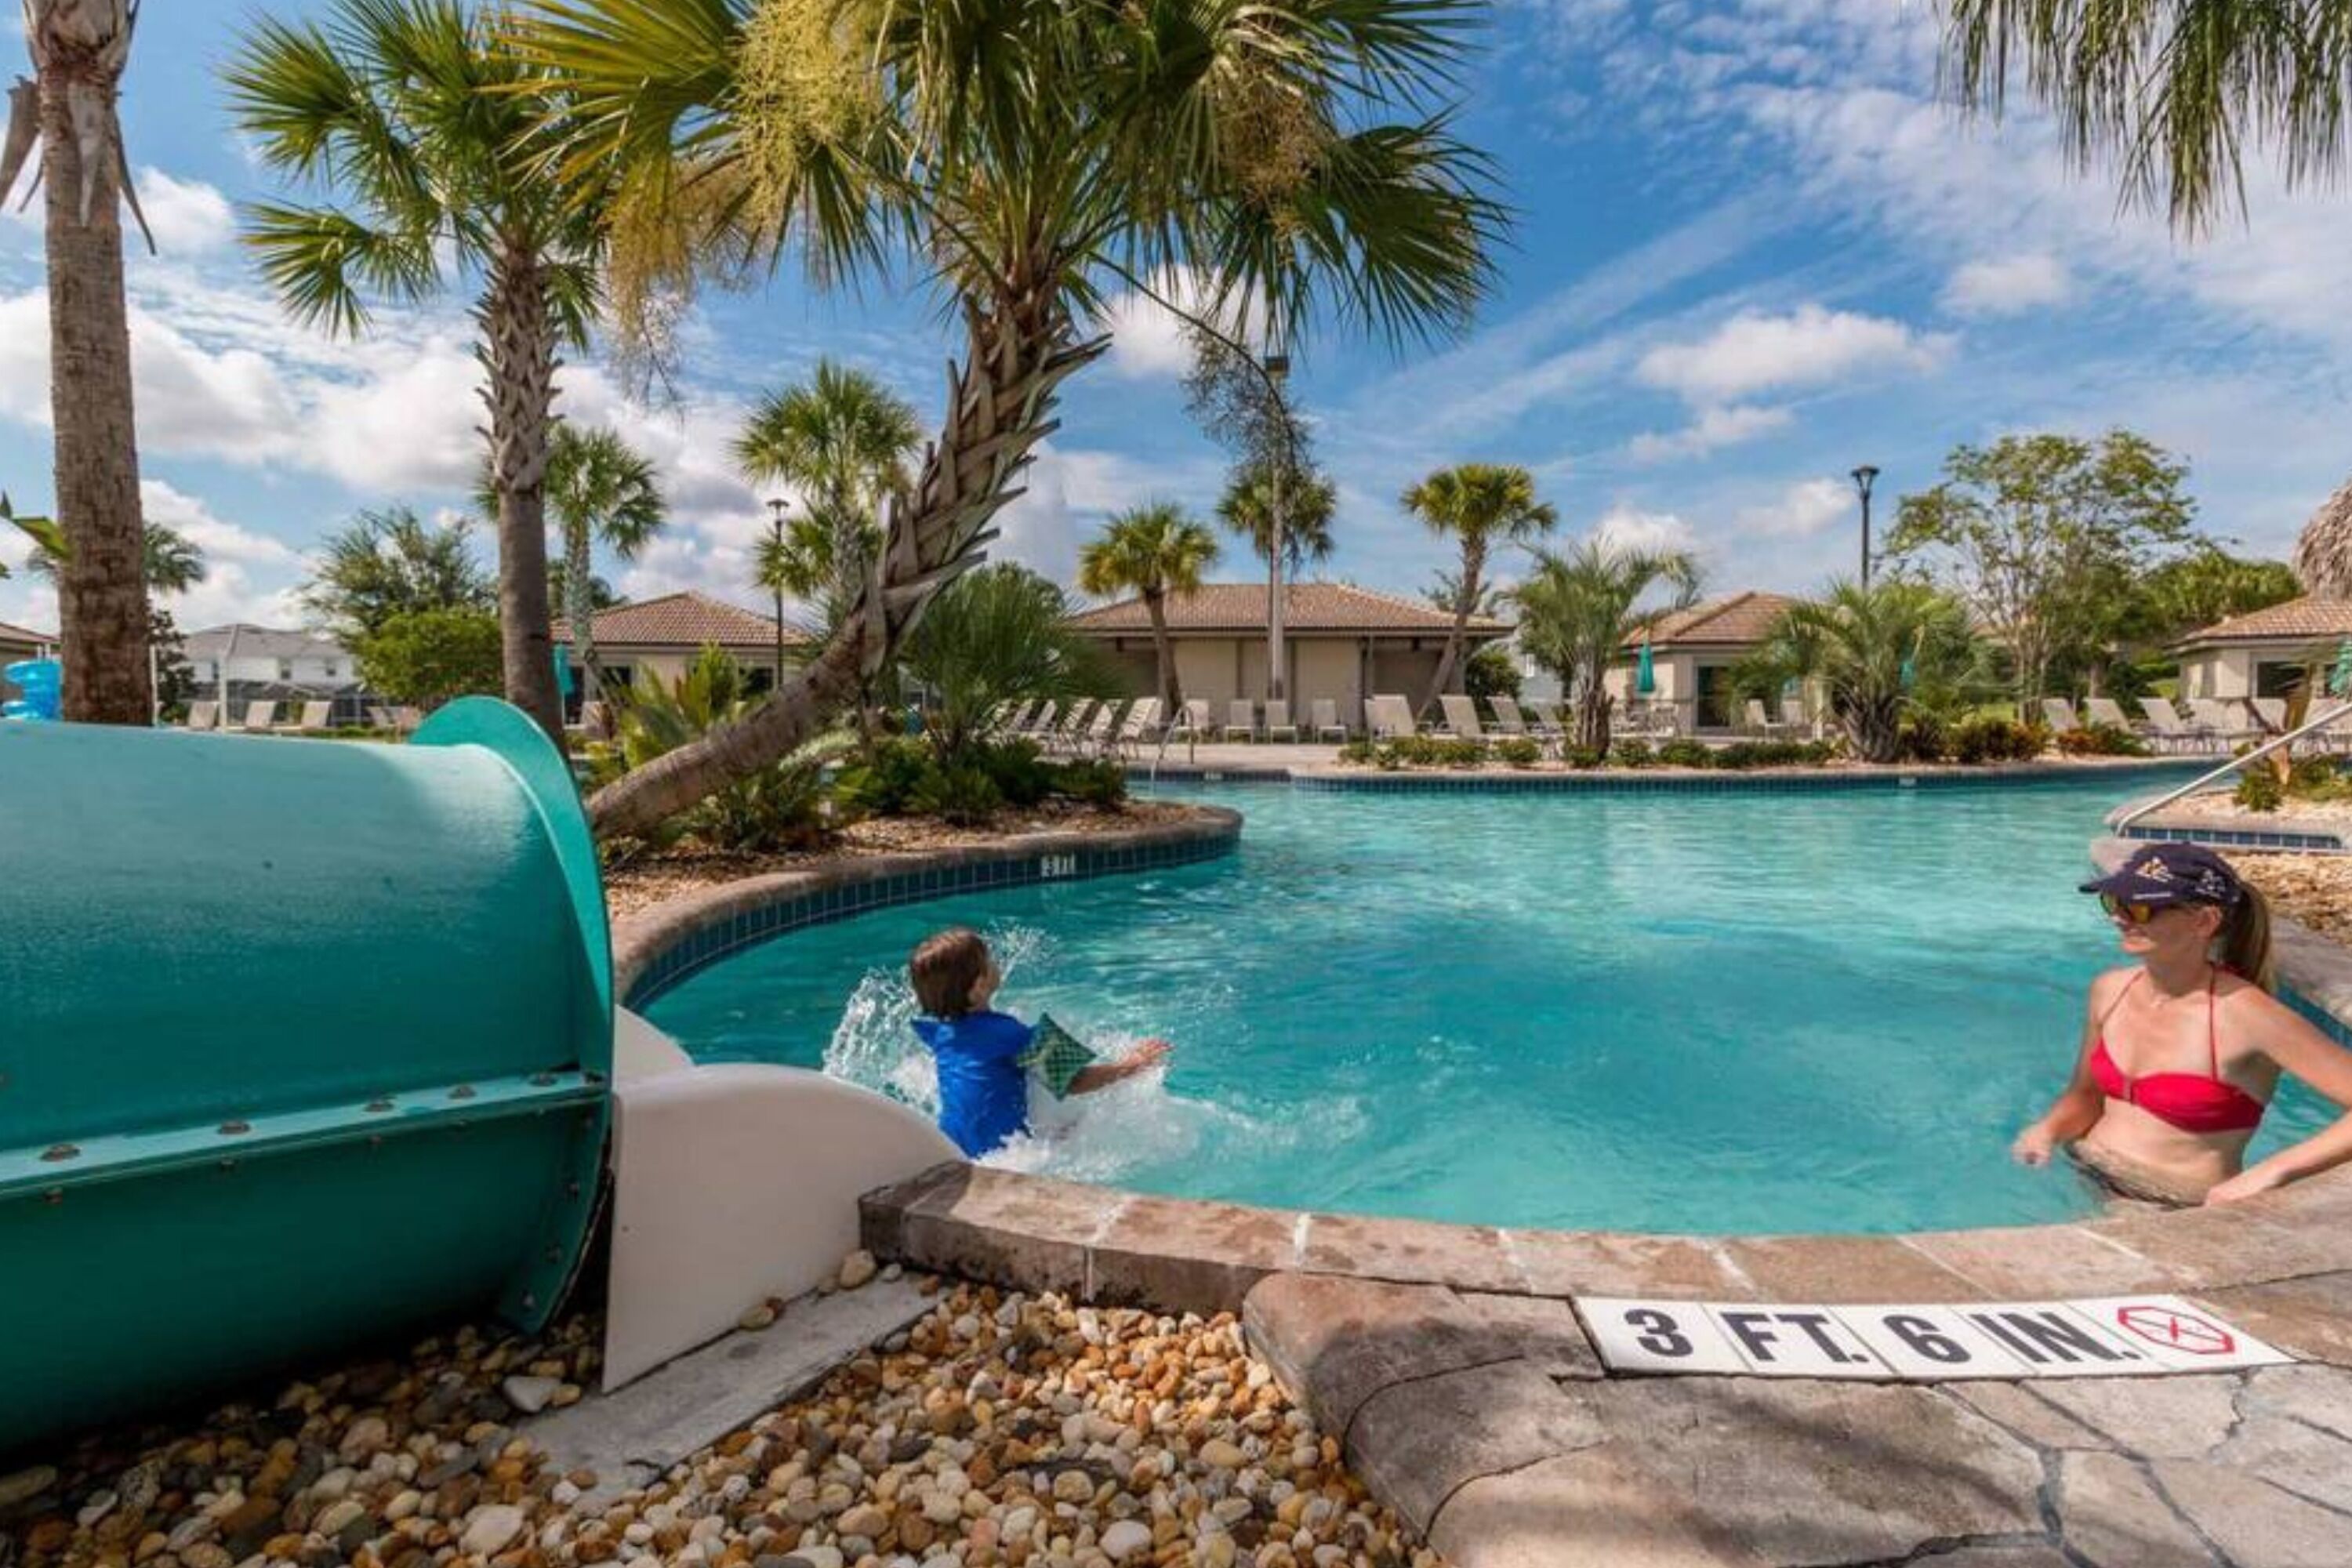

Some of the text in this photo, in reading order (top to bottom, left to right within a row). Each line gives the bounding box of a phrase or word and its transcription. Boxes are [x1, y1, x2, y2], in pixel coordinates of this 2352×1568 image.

[1624, 1308, 2142, 1363] 3 FT. 6 IN.
